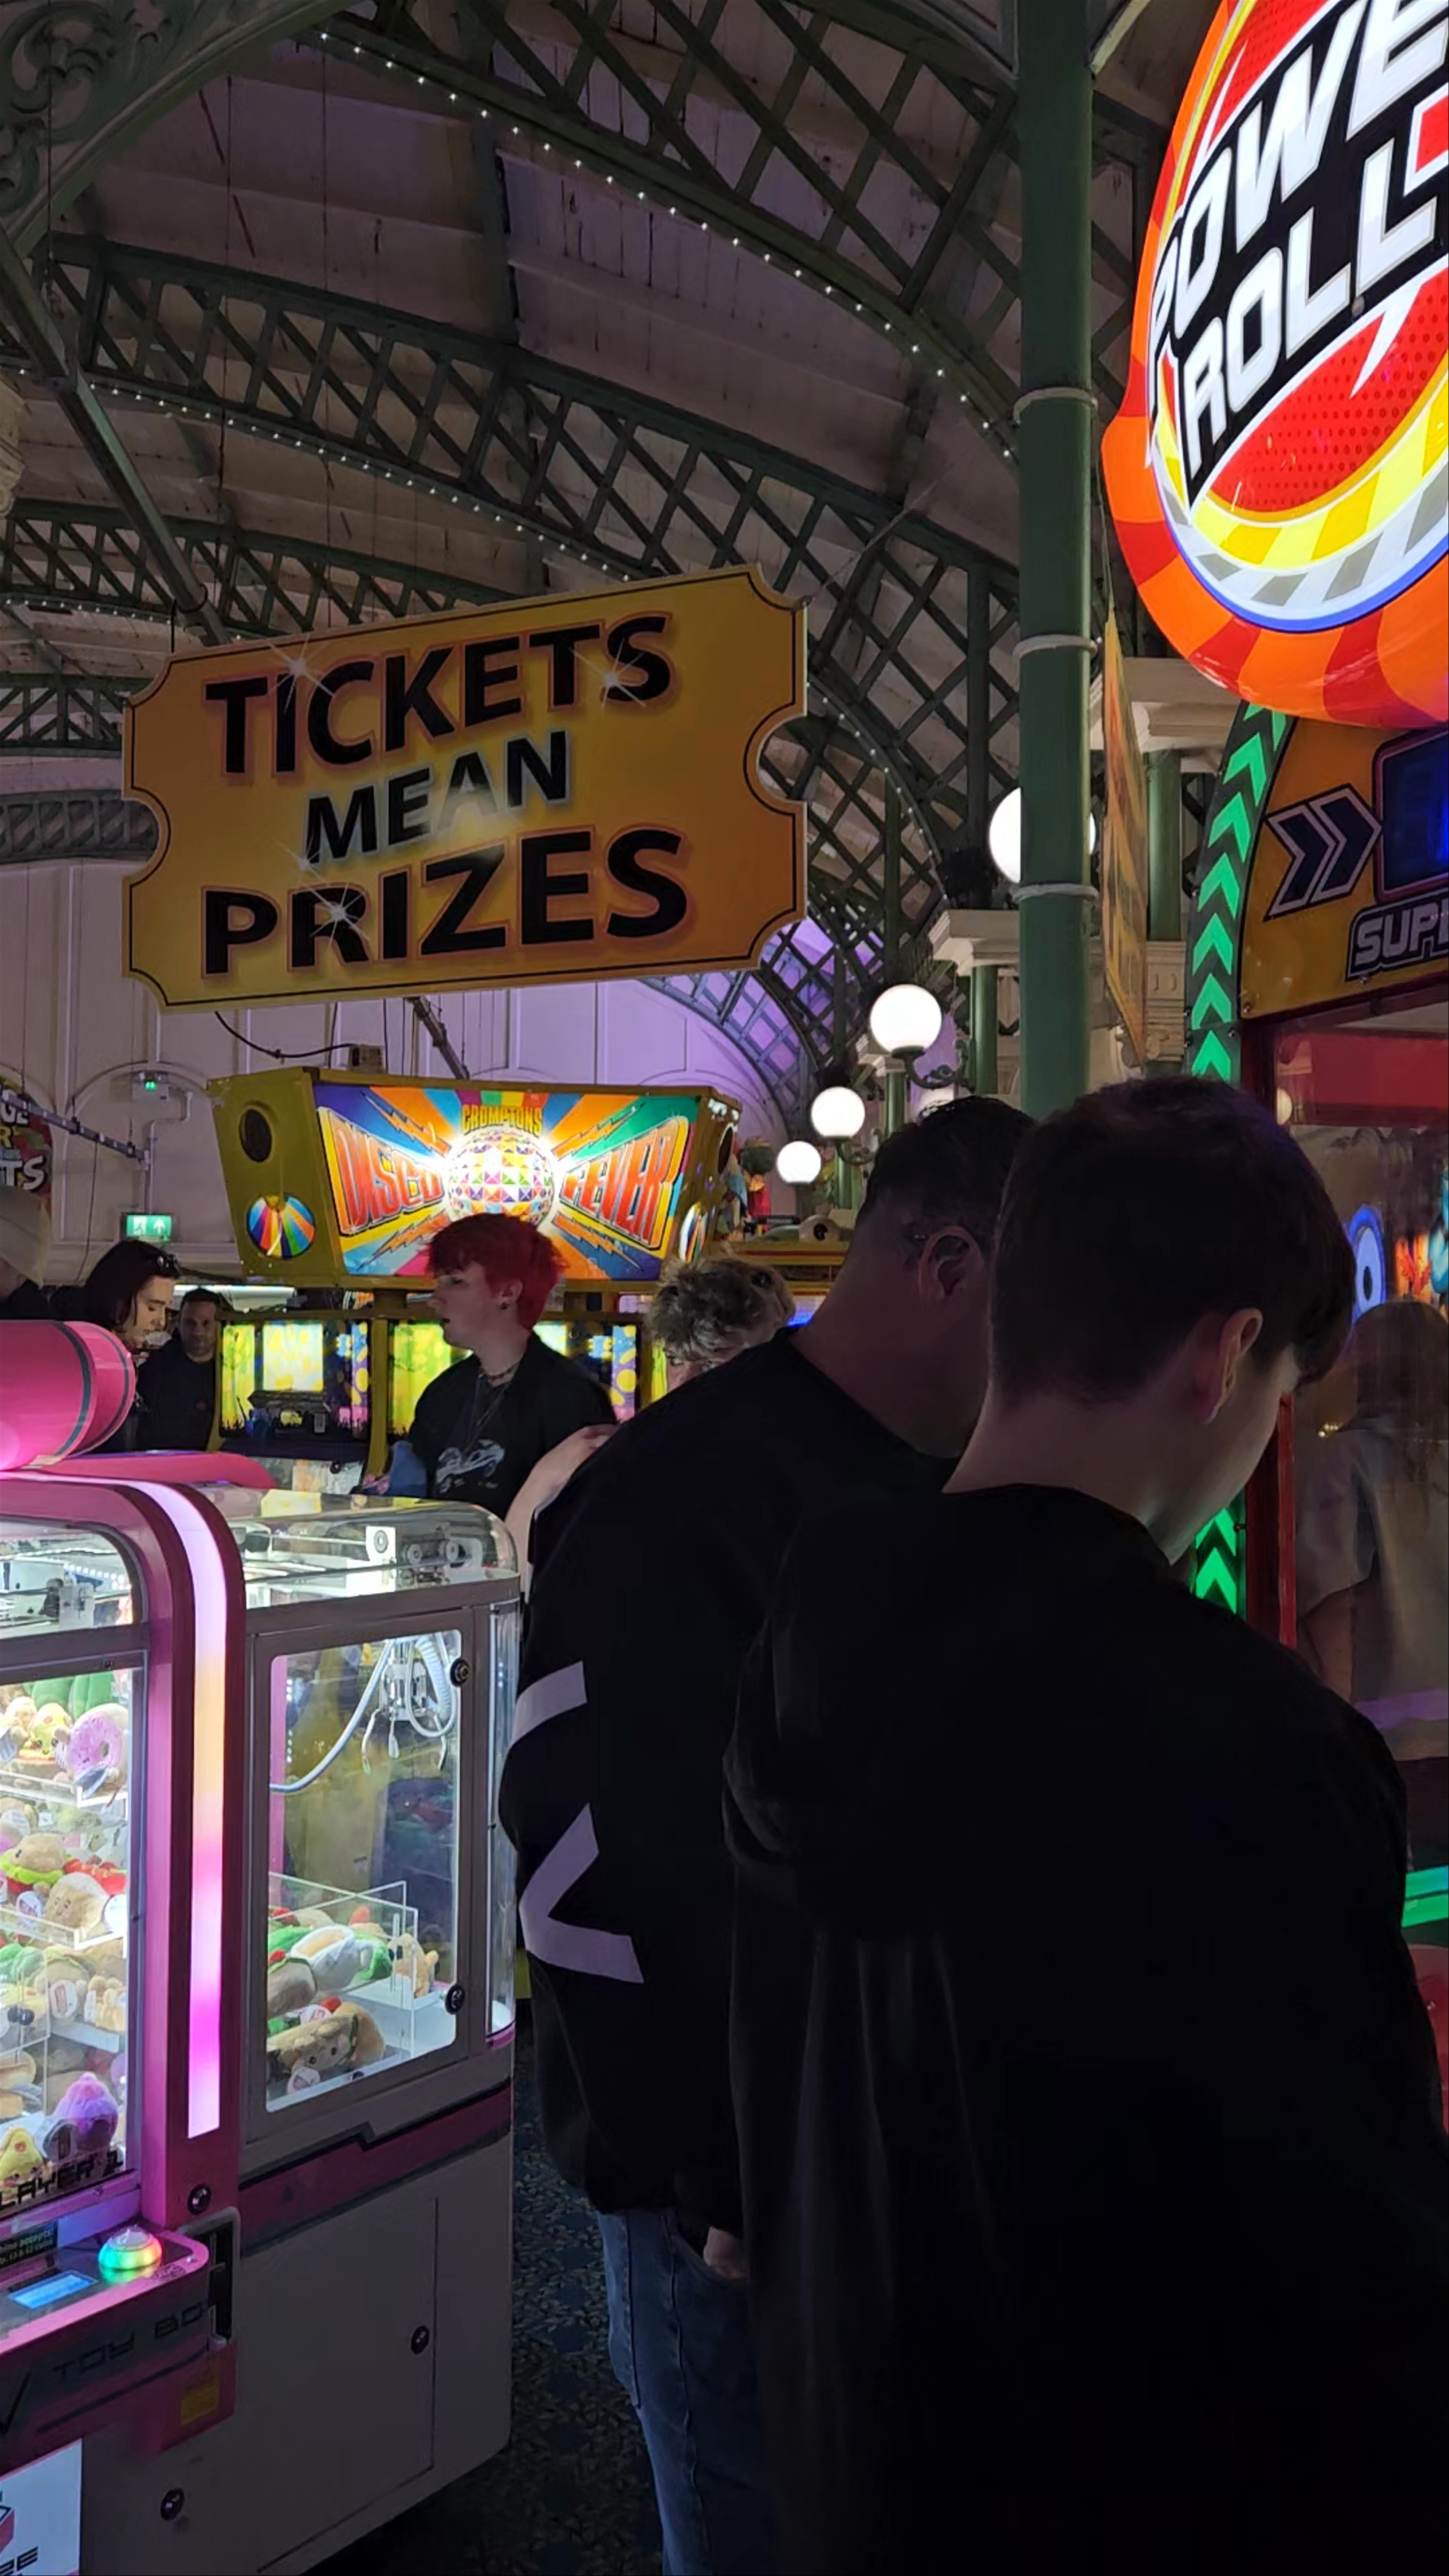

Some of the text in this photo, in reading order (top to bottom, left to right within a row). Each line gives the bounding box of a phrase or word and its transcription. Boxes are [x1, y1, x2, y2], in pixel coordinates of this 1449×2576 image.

[1183, 137, 1437, 481] ROLL
[205, 612, 672, 774] TICKETS
[306, 731, 567, 864] MEAN
[203, 829, 688, 974] PRIZES
[327, 1109, 684, 1246] DISCO FEVER
[462, 1104, 543, 1136] CROMPTONS
[52, 2332, 135, 2382] TOY
